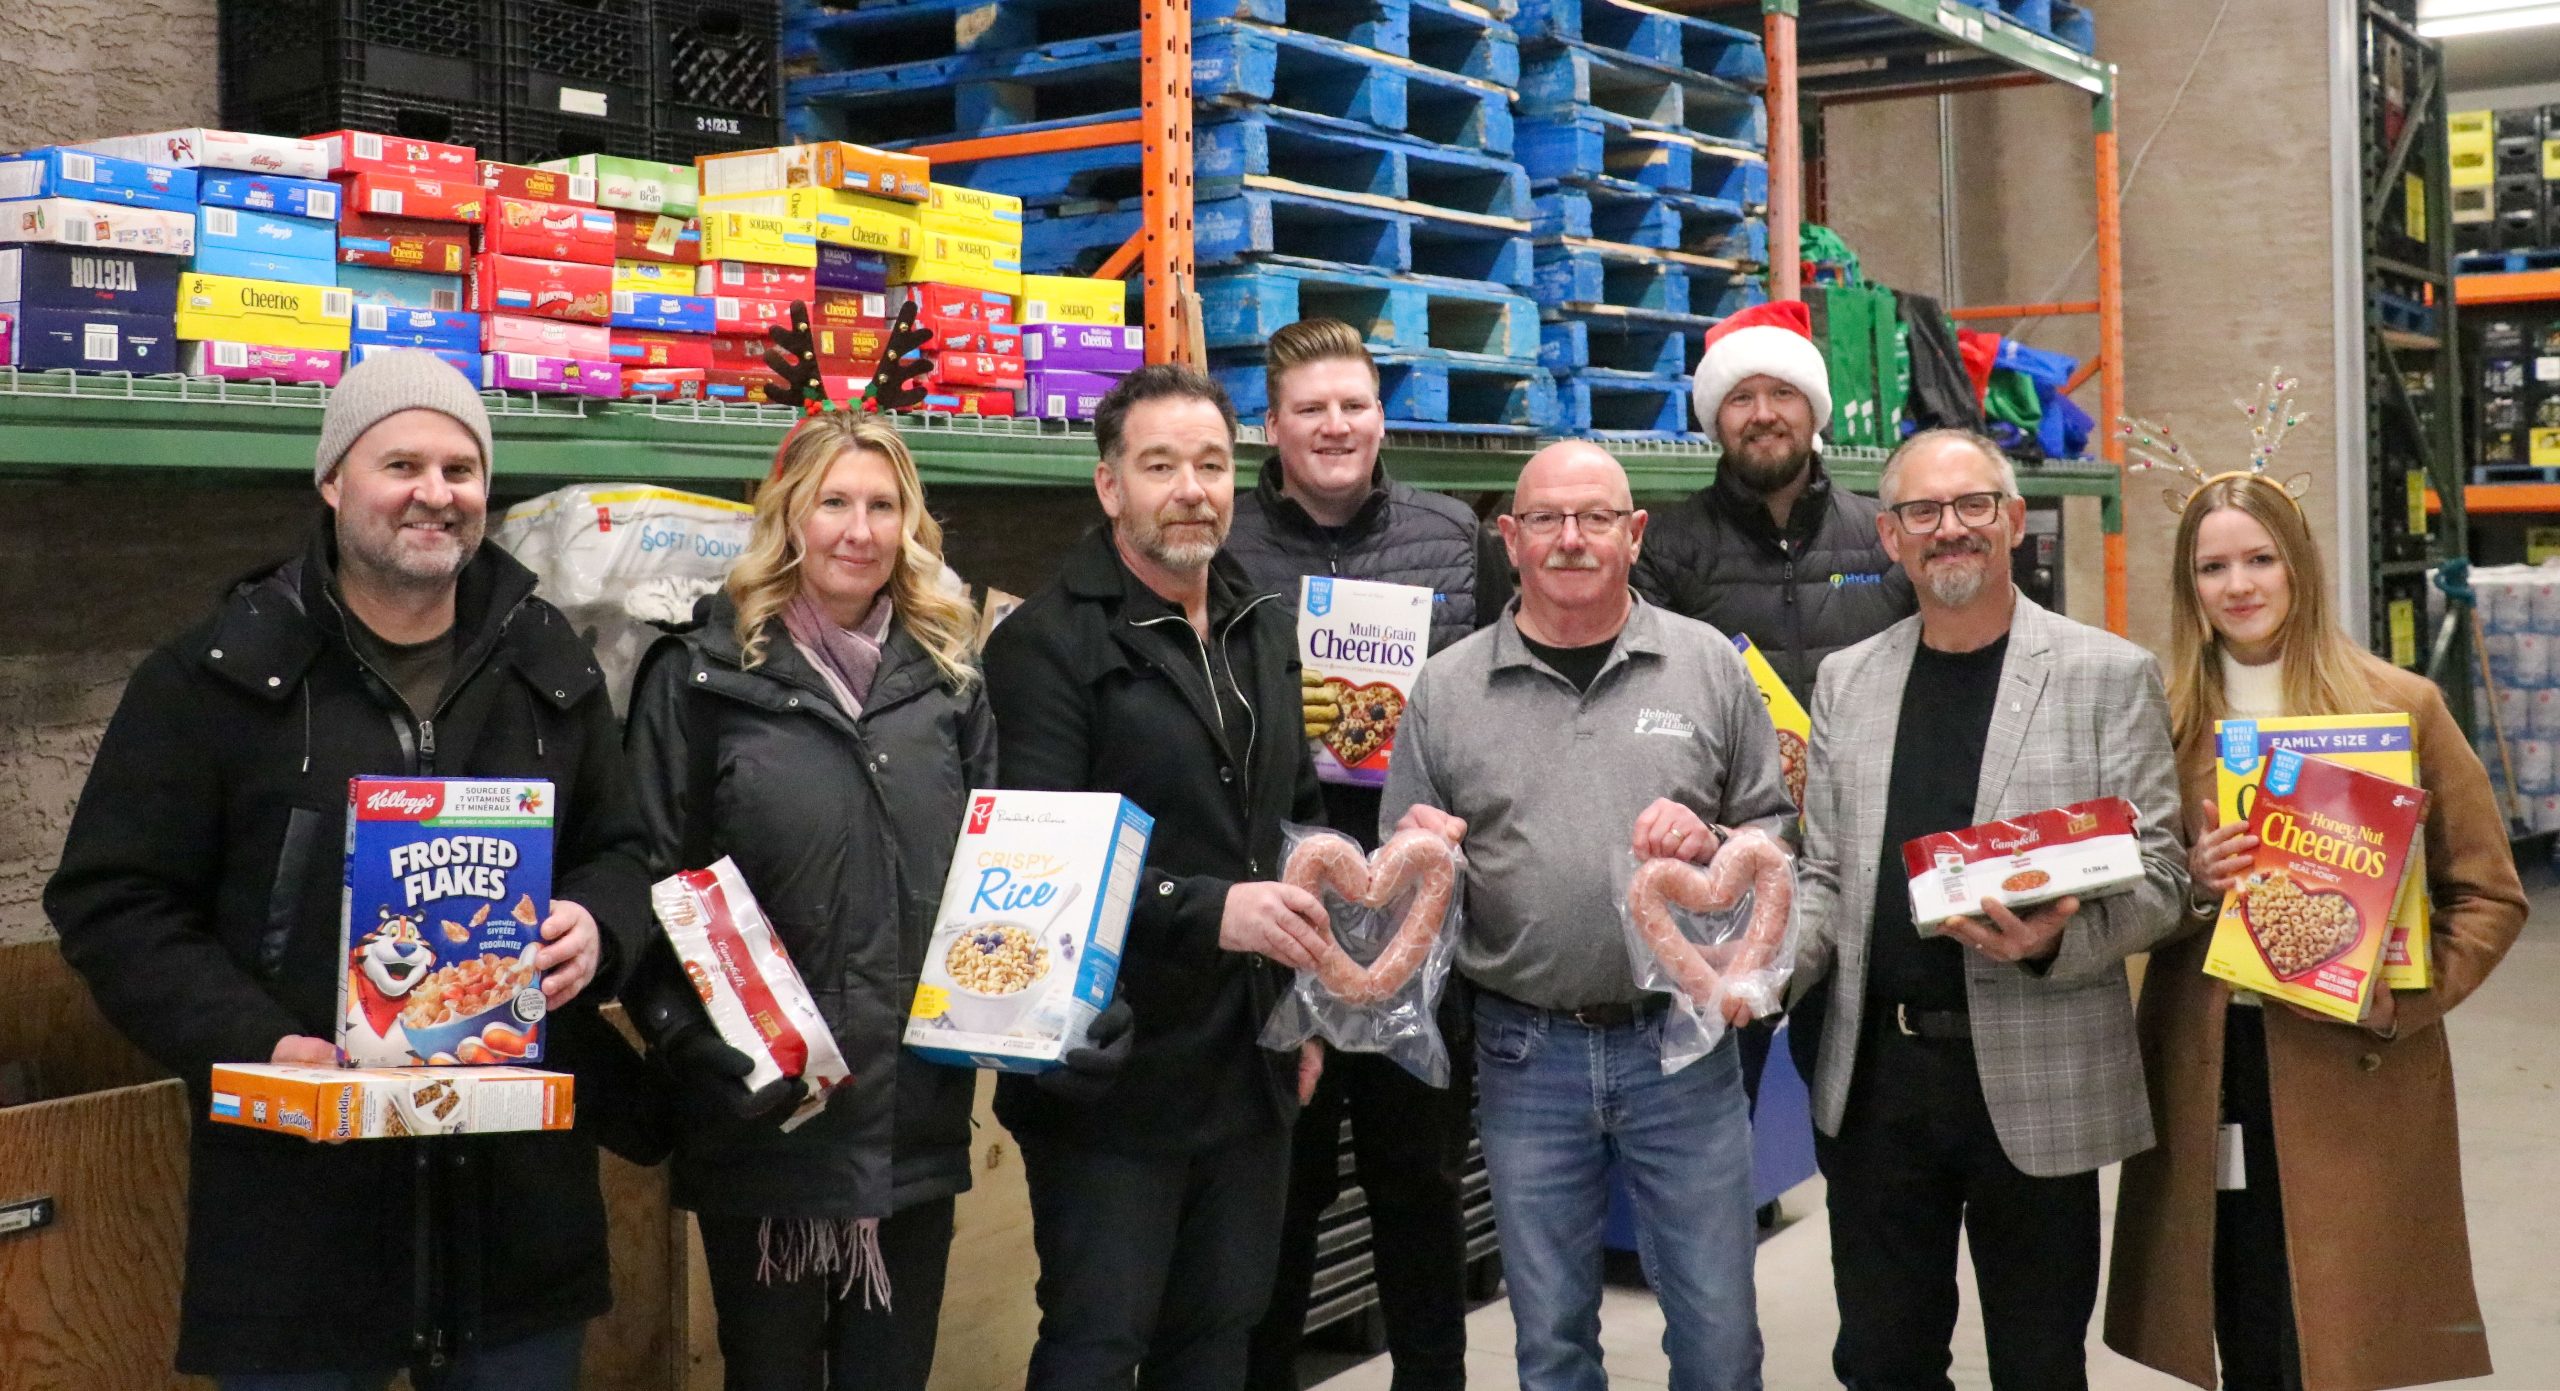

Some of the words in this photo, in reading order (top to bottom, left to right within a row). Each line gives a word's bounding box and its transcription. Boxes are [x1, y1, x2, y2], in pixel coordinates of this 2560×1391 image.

[640, 191, 661, 202] Bran
[954, 192, 990, 210] Cheerios
[705, 216, 714, 254] Cheerios
[749, 218, 783, 235] Cheerios
[852, 226, 889, 246] Cheerios
[958, 241, 991, 260] Cheerios
[70, 256, 137, 291] VECTOR
[241, 287, 299, 311] Cheerios
[1060, 304, 1094, 320] Cheerios
[1080, 331, 1113, 348] Cheerios
[696, 533, 743, 558] DOUX
[1349, 622, 1381, 638] Multi
[1384, 625, 1416, 641] Grain
[1310, 629, 1415, 667] Cheerios
[1639, 708, 1683, 722] Helping
[1662, 719, 1696, 731] Hands
[2271, 735, 2329, 748] FAMILY
[2333, 734, 2368, 746] SIZE
[467, 795, 511, 803] VITAMINES
[500, 787, 511, 795] DE
[367, 789, 437, 814] Kellogg's
[2310, 811, 2356, 840] Honey
[2358, 825, 2385, 846] Nut
[1989, 829, 2040, 850] Campbell's
[2261, 812, 2387, 878] Cheerios
[390, 835, 518, 879] FROSTED
[977, 851, 1055, 870] CRISPY
[2288, 861, 2310, 873] REAL
[2312, 869, 2342, 884] HONEY
[404, 865, 506, 908] FLAKES
[969, 866, 1059, 914] Rice
[487, 926, 516, 935] GIVRÉES
[479, 940, 522, 950] CROQUANTES
[717, 939, 747, 987] Campbell's
[278, 1109, 313, 1132] Shreddies
[338, 1086, 352, 1137] Shreddies
